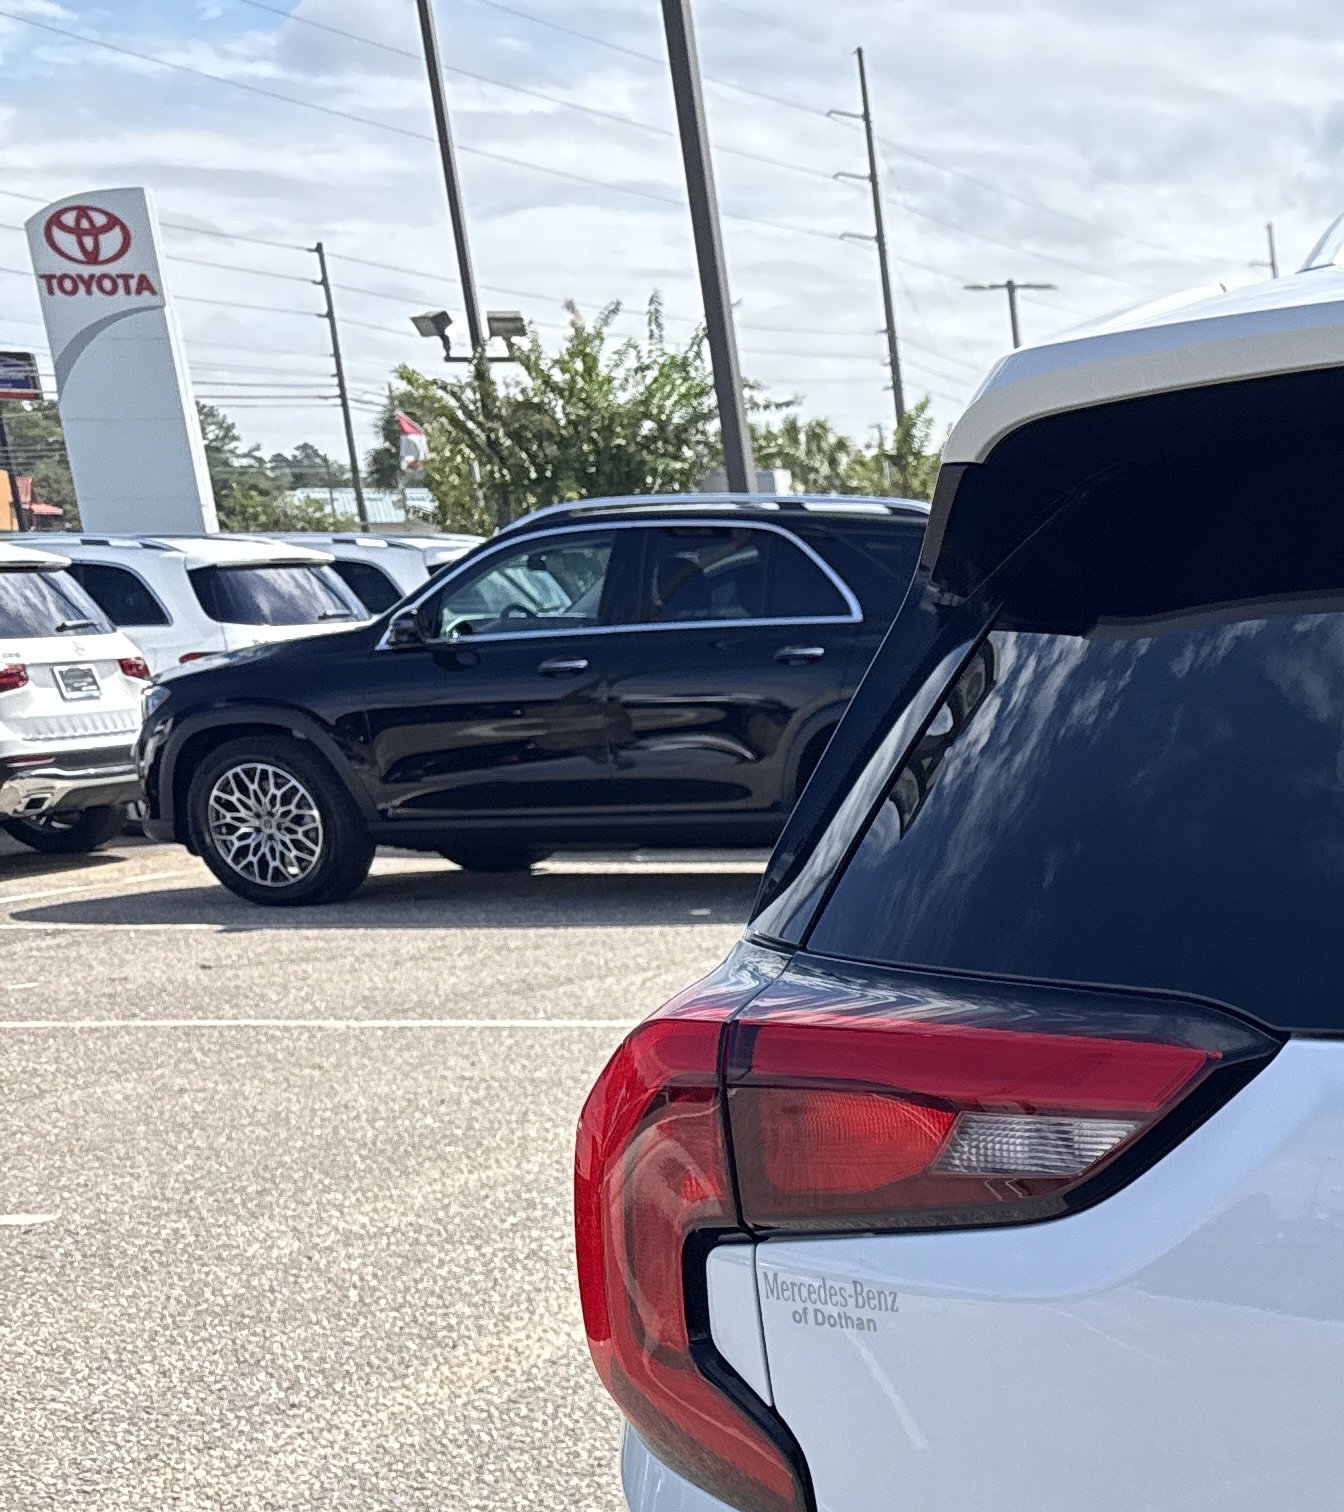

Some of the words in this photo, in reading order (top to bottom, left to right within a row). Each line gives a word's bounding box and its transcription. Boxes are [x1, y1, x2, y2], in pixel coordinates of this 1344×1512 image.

[38, 272, 157, 297] TOYOTA
[763, 1271, 899, 1313] Mercedes-Benz
[792, 1306, 808, 1325] of
[813, 1308, 877, 1332] Dothan
